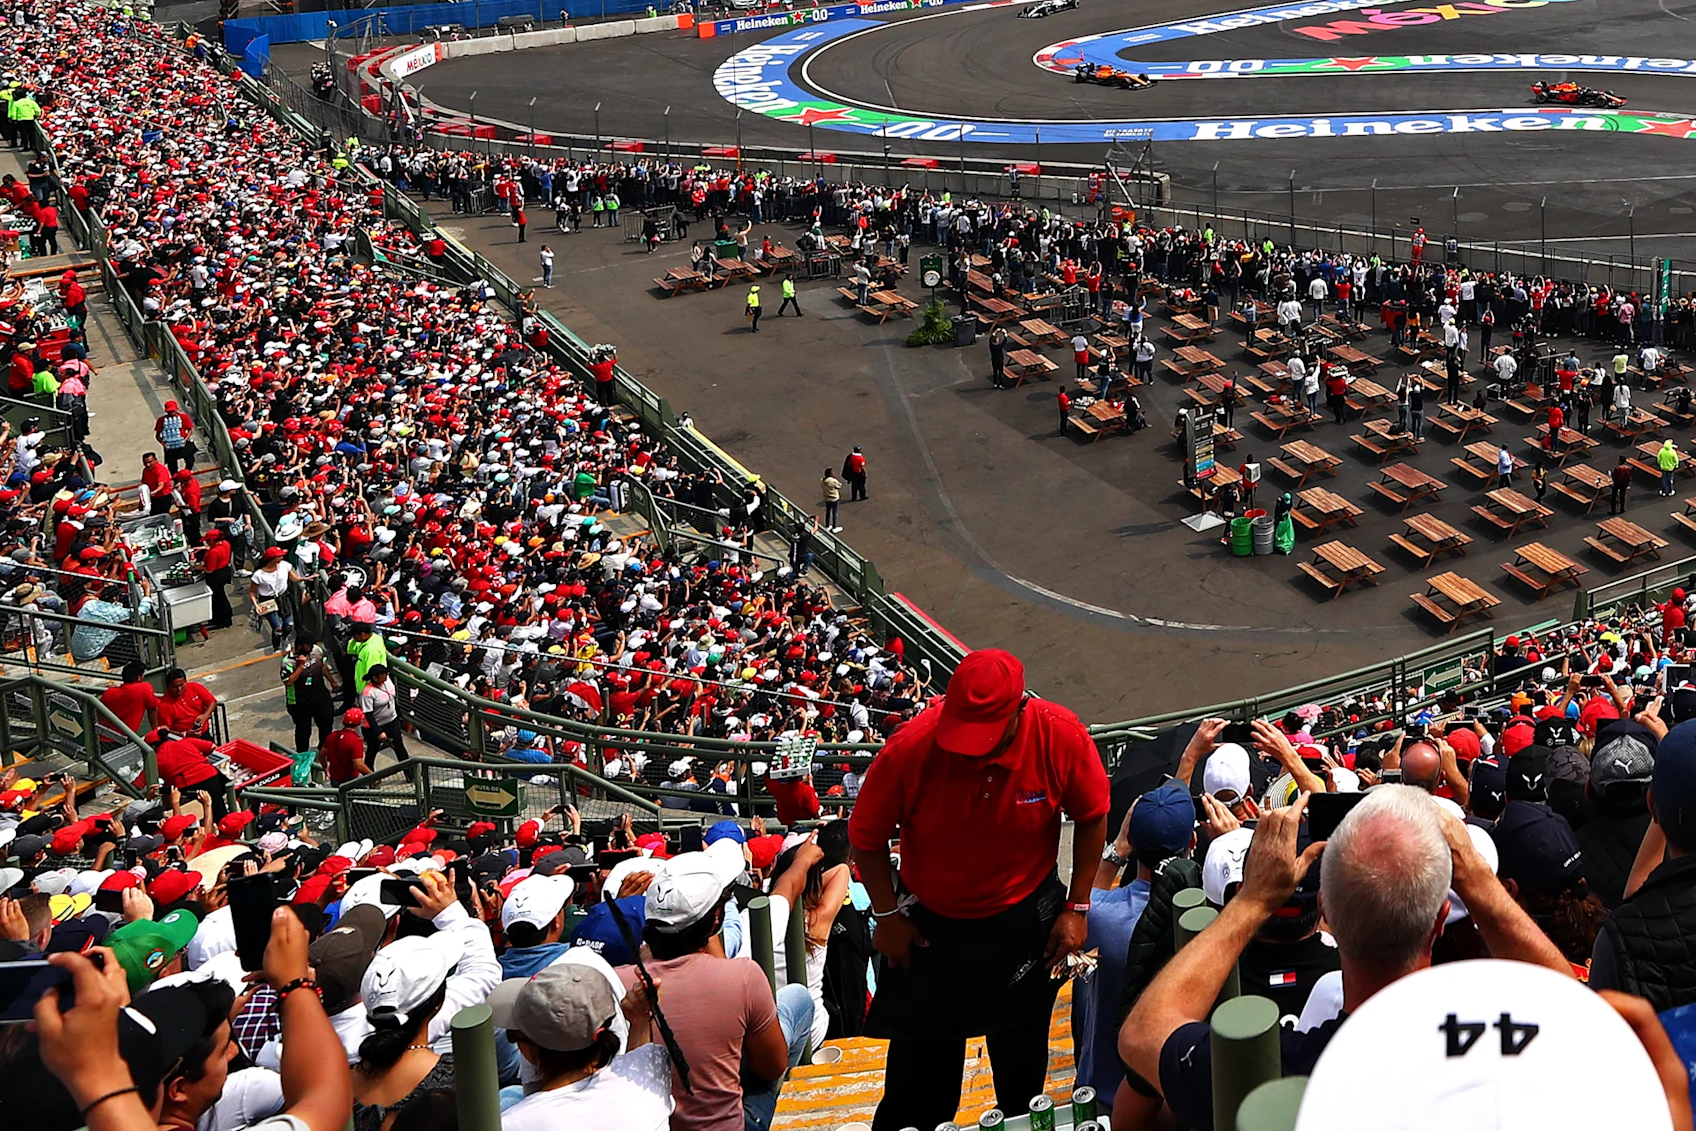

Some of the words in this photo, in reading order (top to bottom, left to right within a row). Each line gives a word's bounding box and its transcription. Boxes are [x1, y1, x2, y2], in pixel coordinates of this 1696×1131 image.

[861, 0, 907, 14] Heineken
[737, 17, 788, 31] Heineken
[712, 44, 809, 114] Heineken
[1190, 114, 1606, 140] Heineken
[1438, 1012, 1540, 1058] 44
